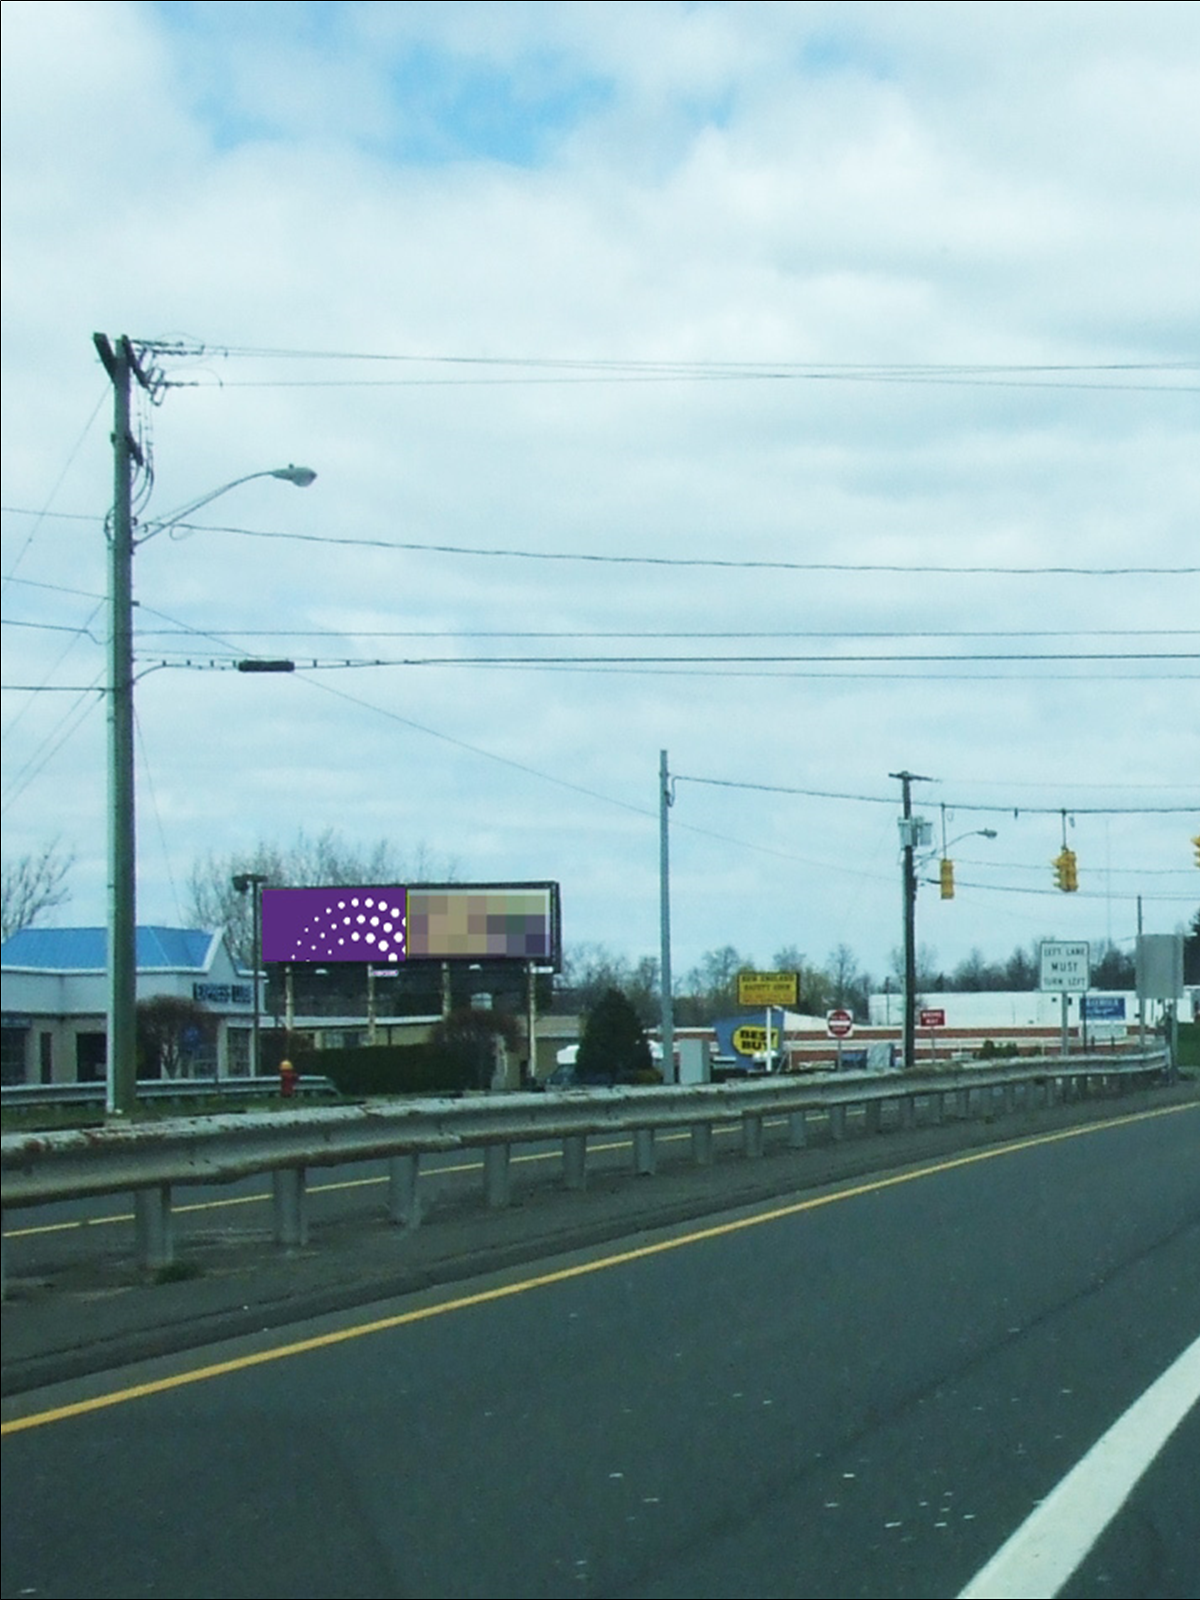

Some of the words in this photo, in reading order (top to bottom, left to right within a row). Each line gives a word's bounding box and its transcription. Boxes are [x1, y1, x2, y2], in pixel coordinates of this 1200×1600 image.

[1043, 947, 1061, 957] LEFT
[1066, 947, 1085, 956] LANE
[1051, 961, 1078, 972] MUST
[1067, 977, 1085, 987] LEFT
[740, 1030, 777, 1041] BEST
